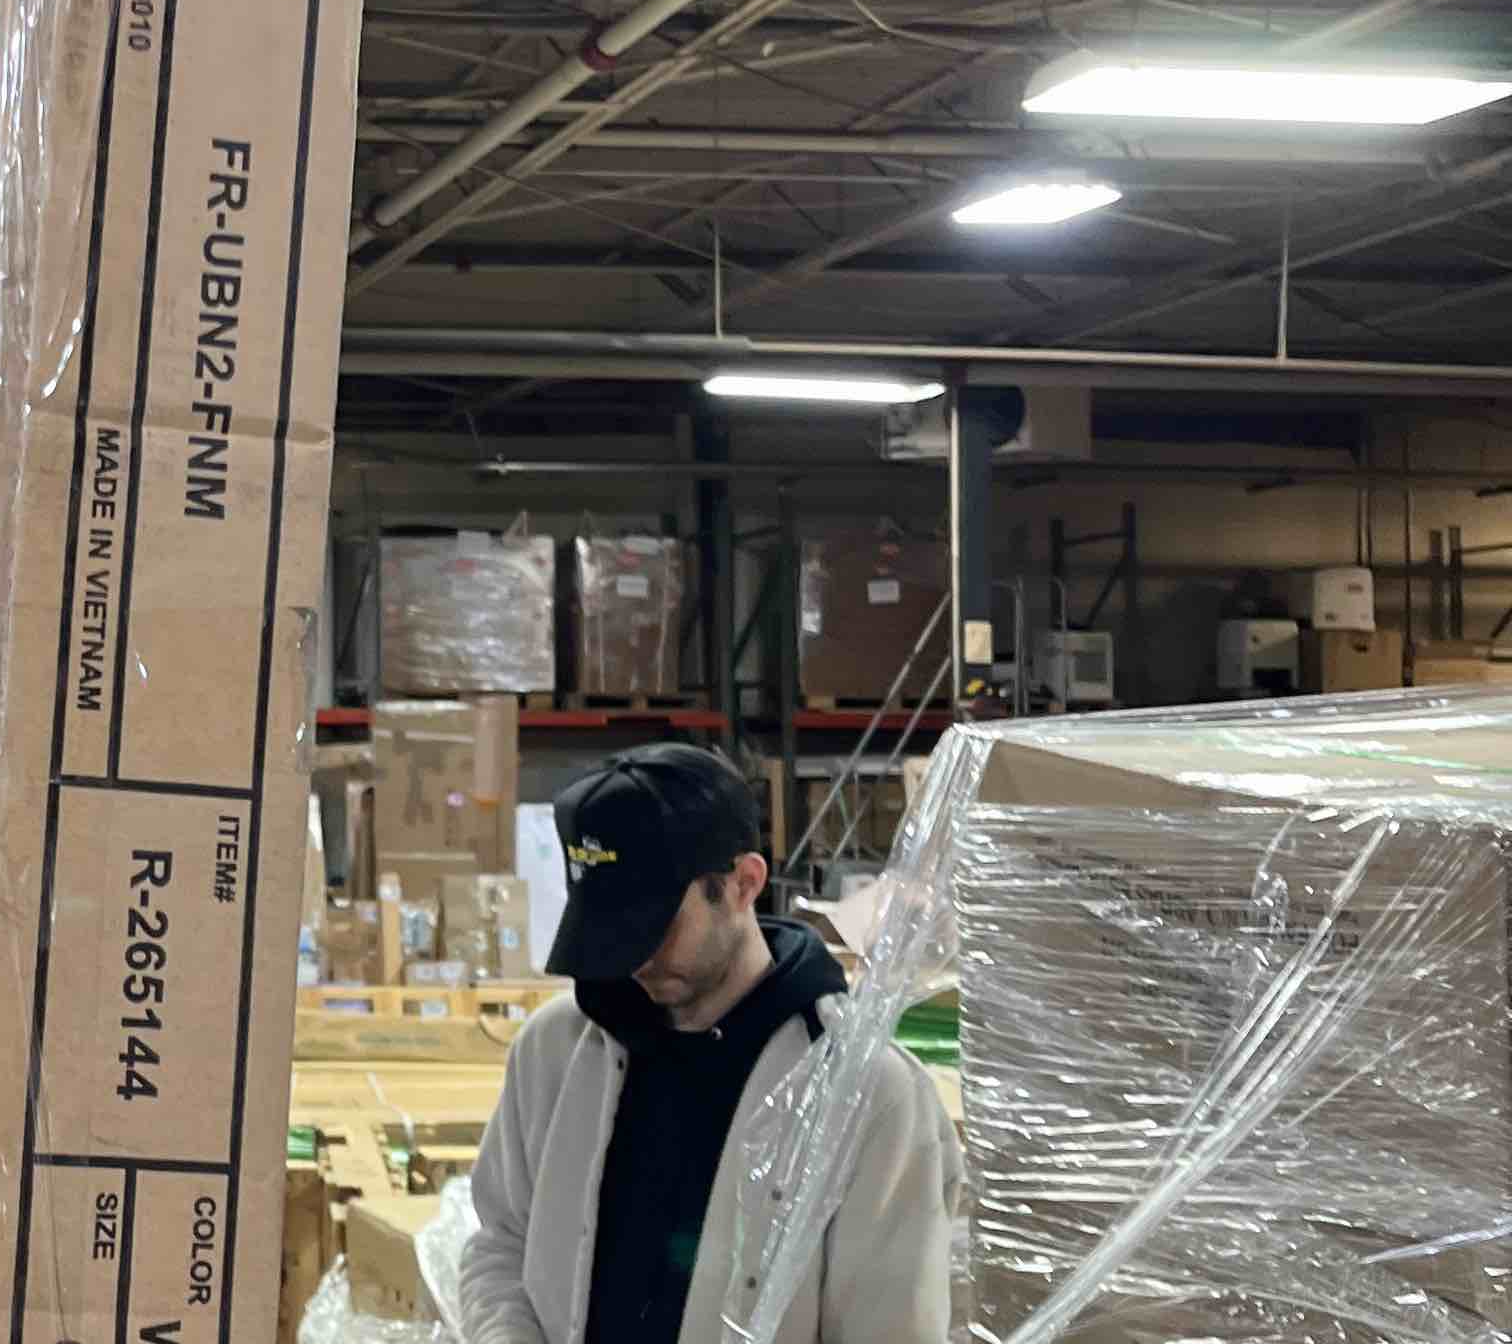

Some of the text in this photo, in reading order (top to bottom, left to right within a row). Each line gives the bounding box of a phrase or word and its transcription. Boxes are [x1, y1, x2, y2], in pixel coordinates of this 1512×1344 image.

[184, 137, 252, 521] FR-UBN2-FNM
[76, 426, 121, 711] MADE IN VIETNAM
[213, 814, 240, 904] ITEM#
[116, 848, 173, 1101] R-265144
[92, 1191, 118, 1261] SIZE
[187, 1196, 217, 1308] COLOR
